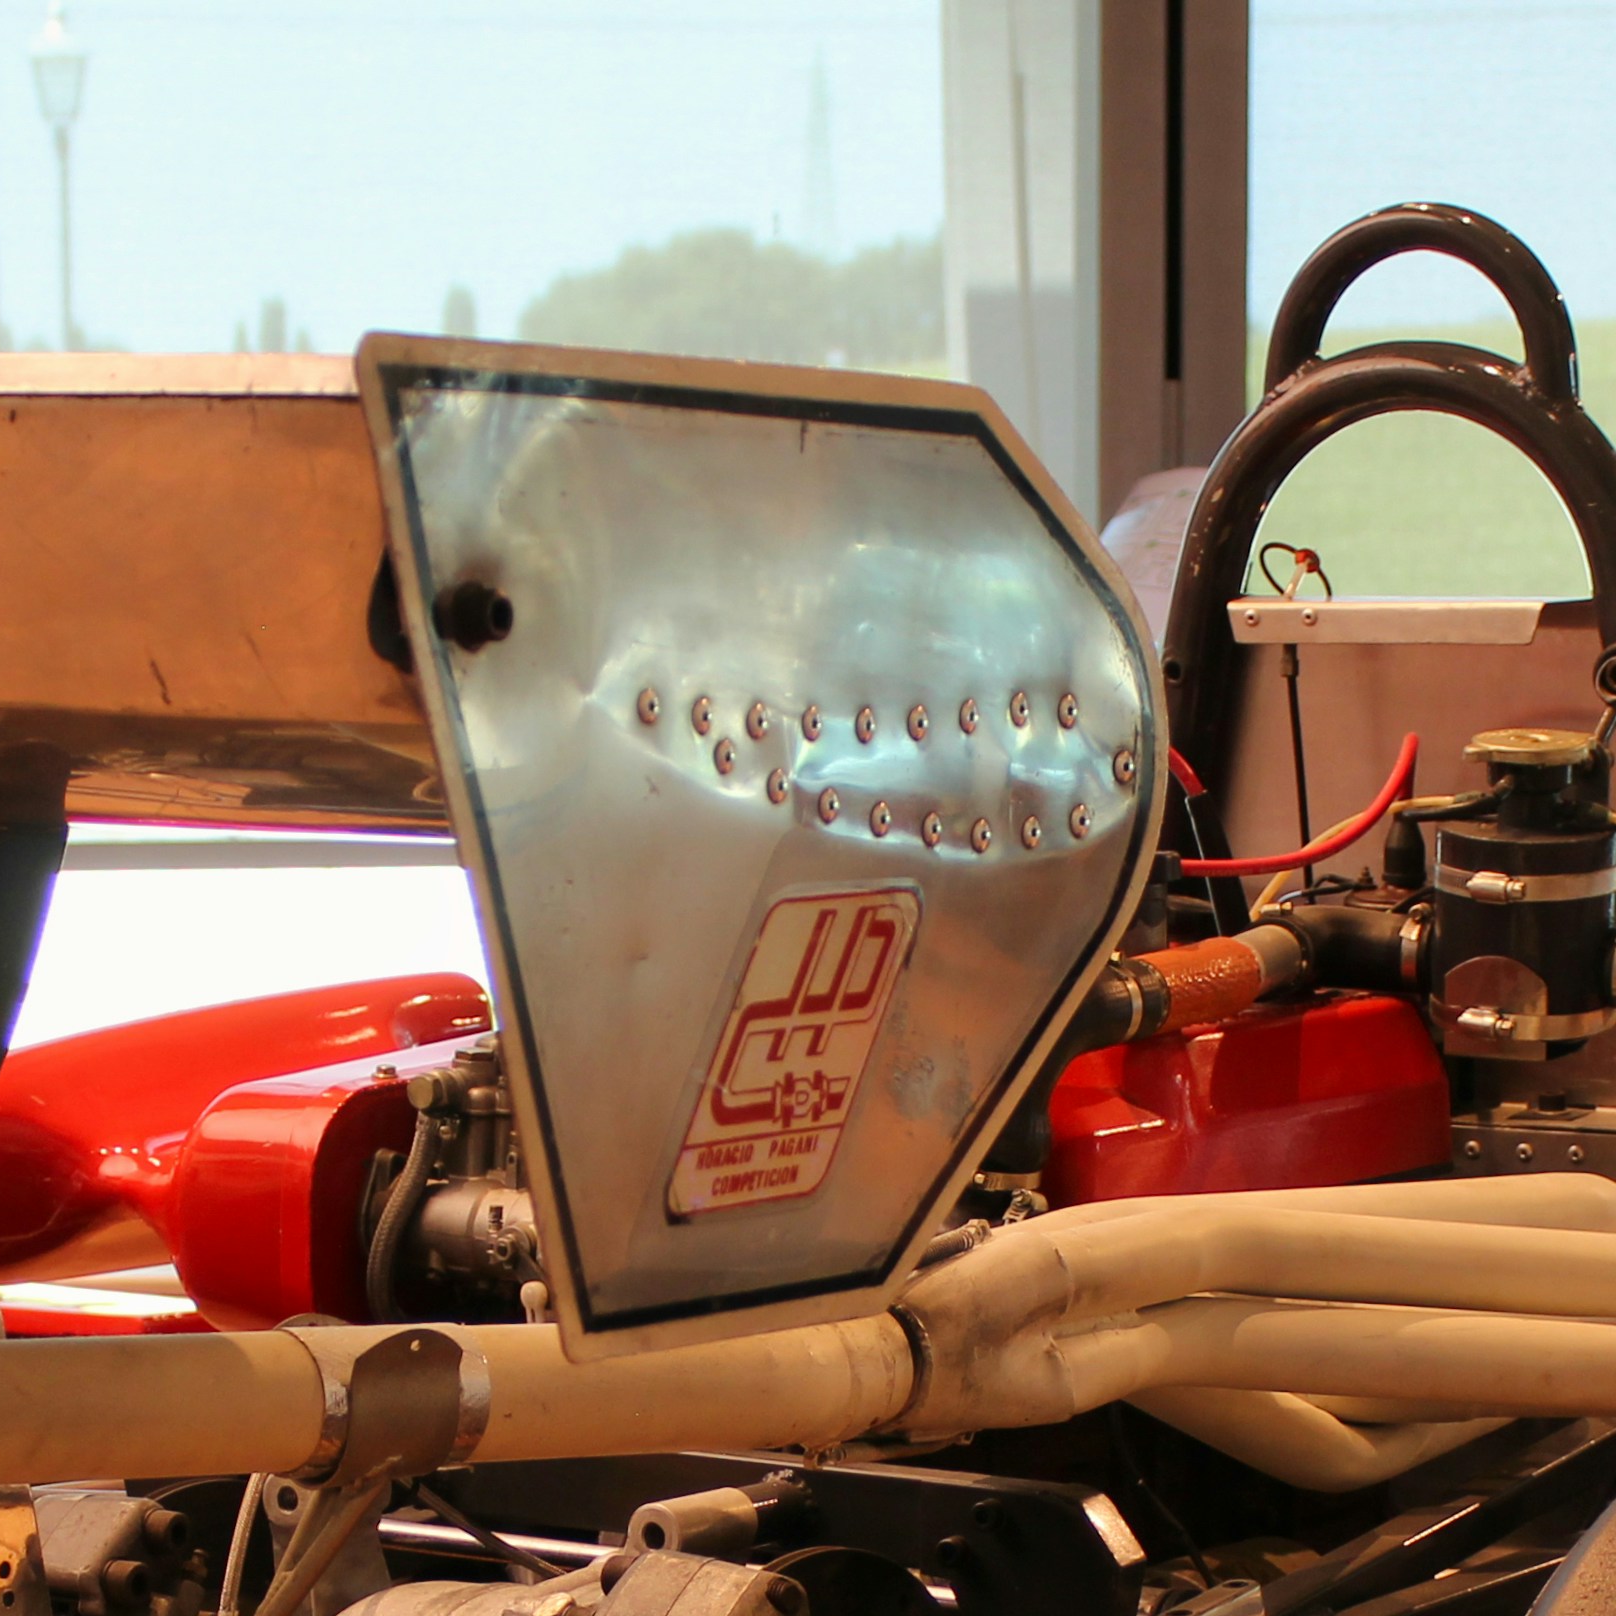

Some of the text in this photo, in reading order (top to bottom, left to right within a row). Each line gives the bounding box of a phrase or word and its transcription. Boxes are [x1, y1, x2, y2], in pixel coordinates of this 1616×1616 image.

[696, 1134, 819, 1170] HORACIO PAGANI
[711, 1165, 799, 1196] COMPETICION
